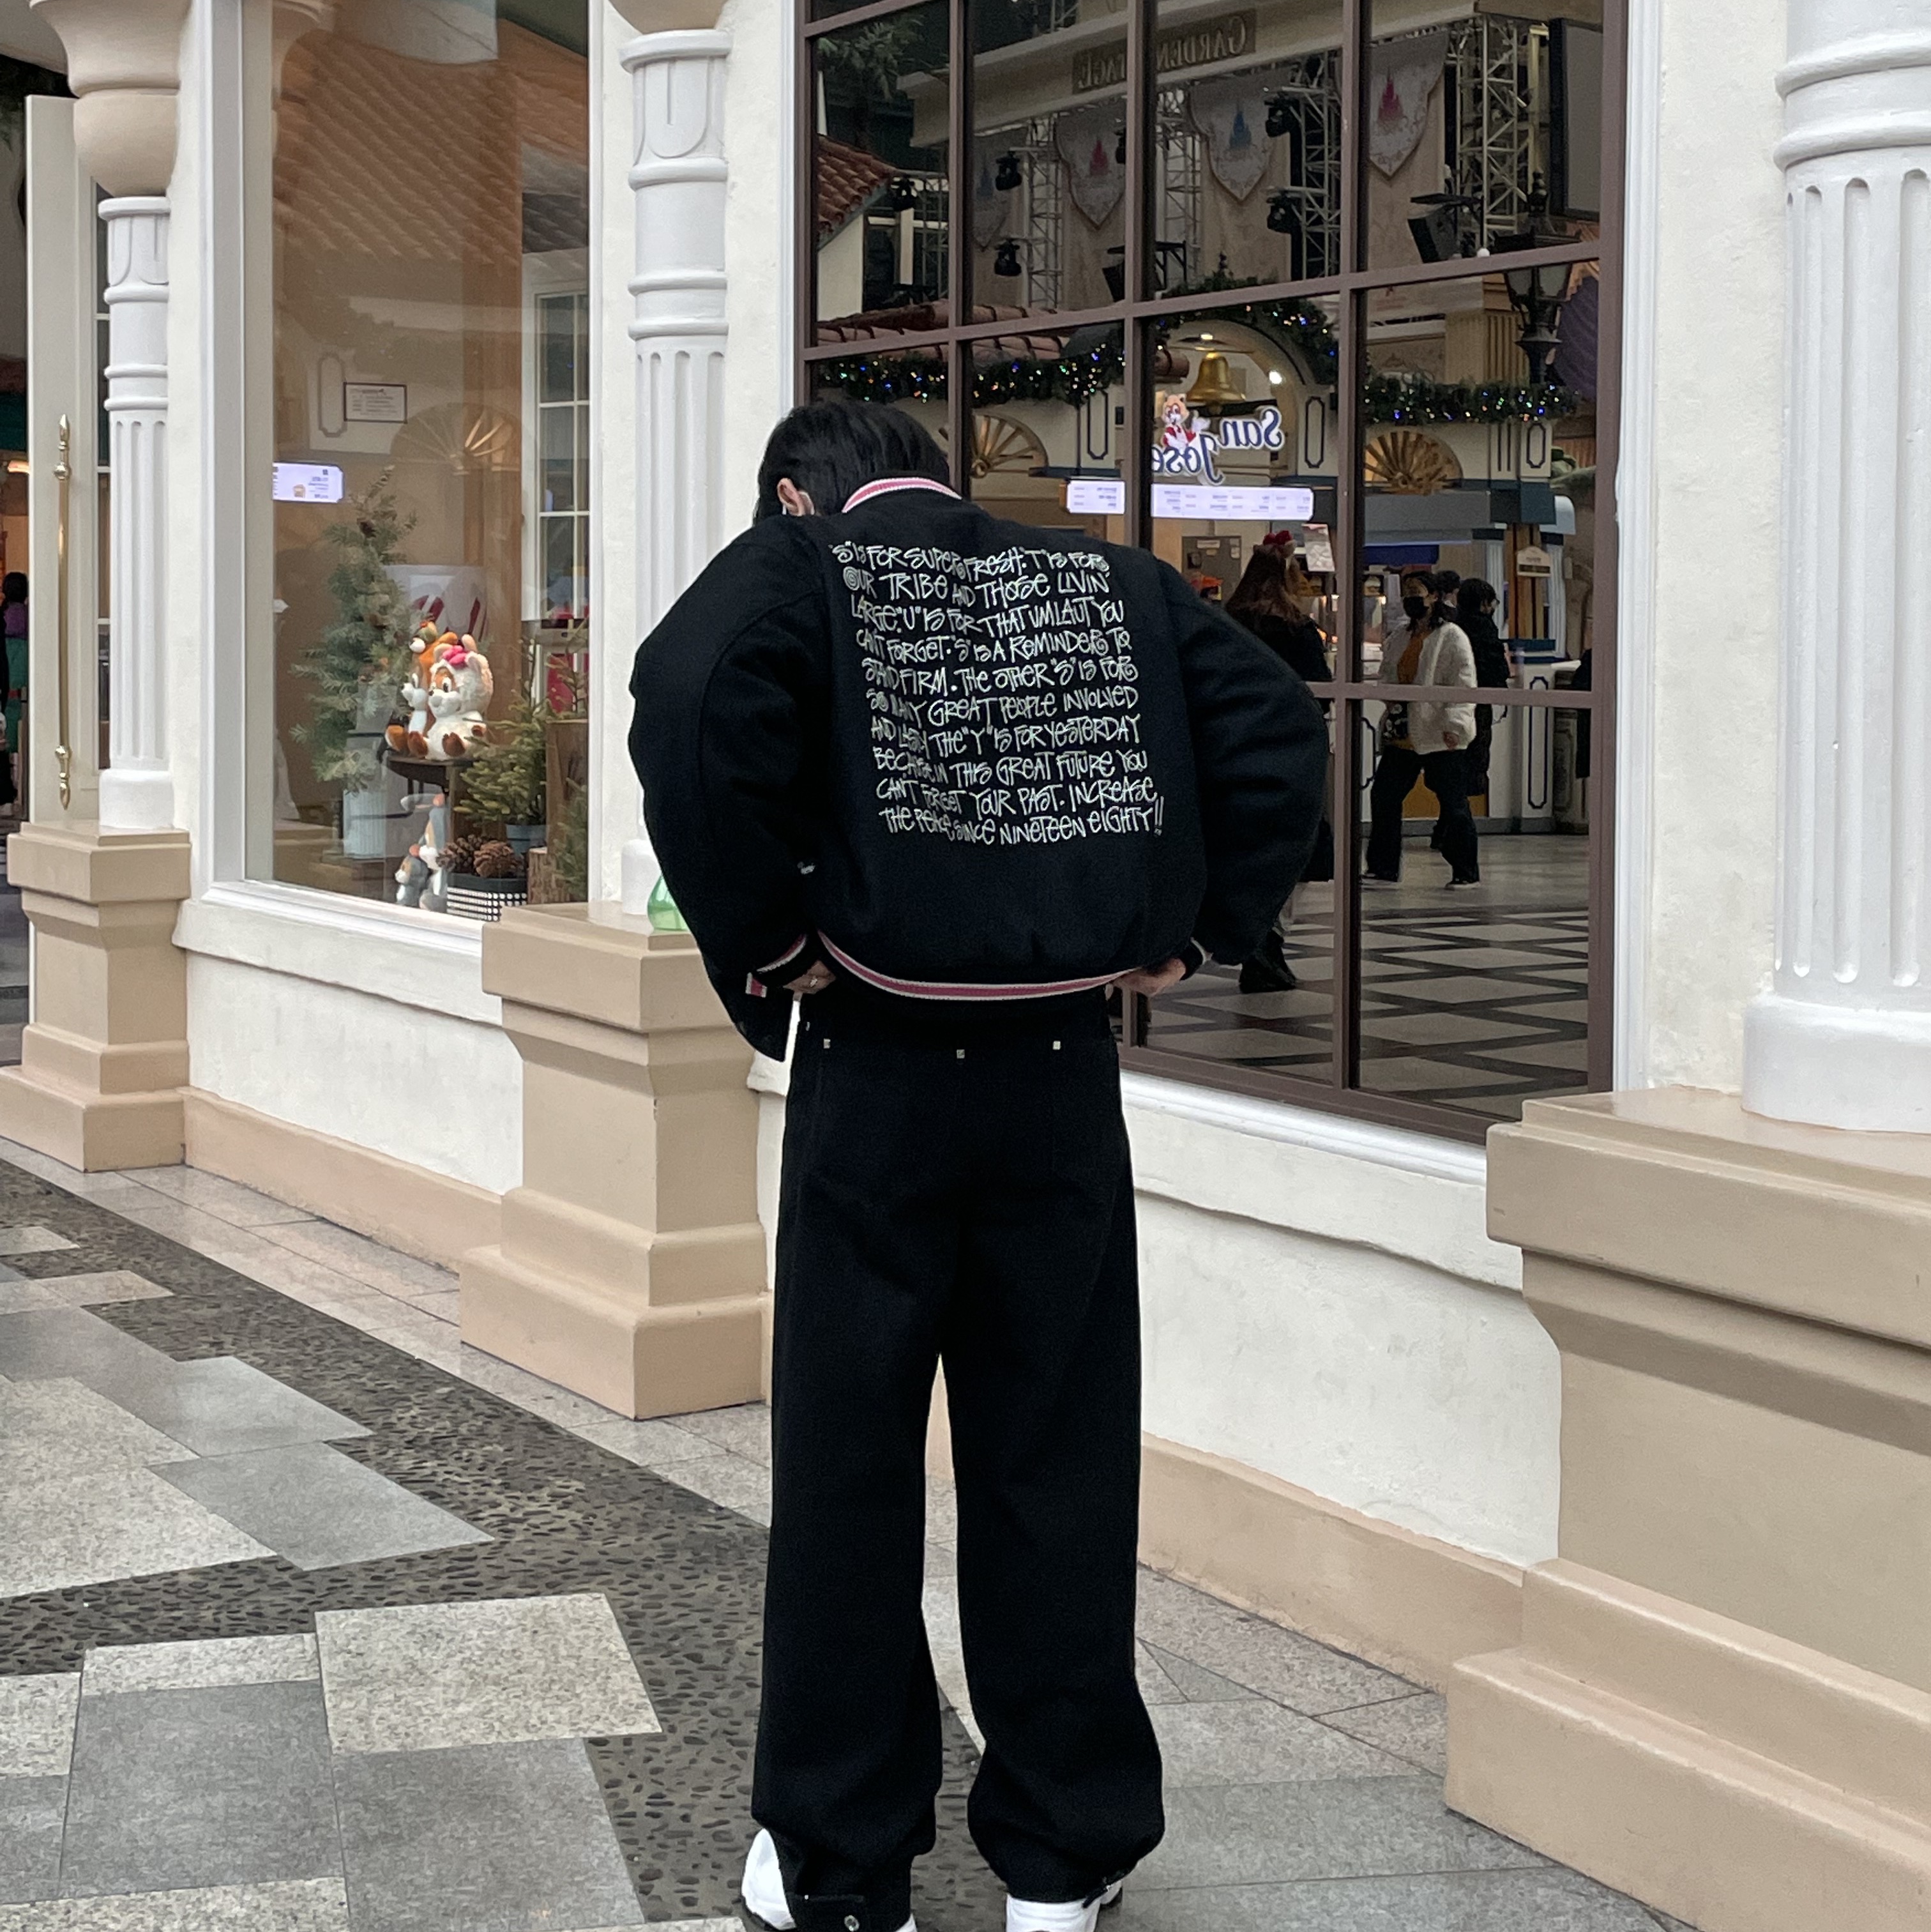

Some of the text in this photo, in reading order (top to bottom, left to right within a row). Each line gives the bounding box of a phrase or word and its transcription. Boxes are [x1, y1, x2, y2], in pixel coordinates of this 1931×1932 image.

[866, 545, 908, 570] FOR
[843, 566, 878, 599] OUR
[879, 572, 948, 601] TRIBE
[946, 607, 983, 635] FOR
[976, 604, 1030, 638] THAT
[1091, 599, 1125, 628] YOU
[993, 639, 1006, 662] A
[1014, 724, 1047, 752] FOR
[1115, 749, 1148, 773] YOU
[968, 787, 1017, 821] YOUR
